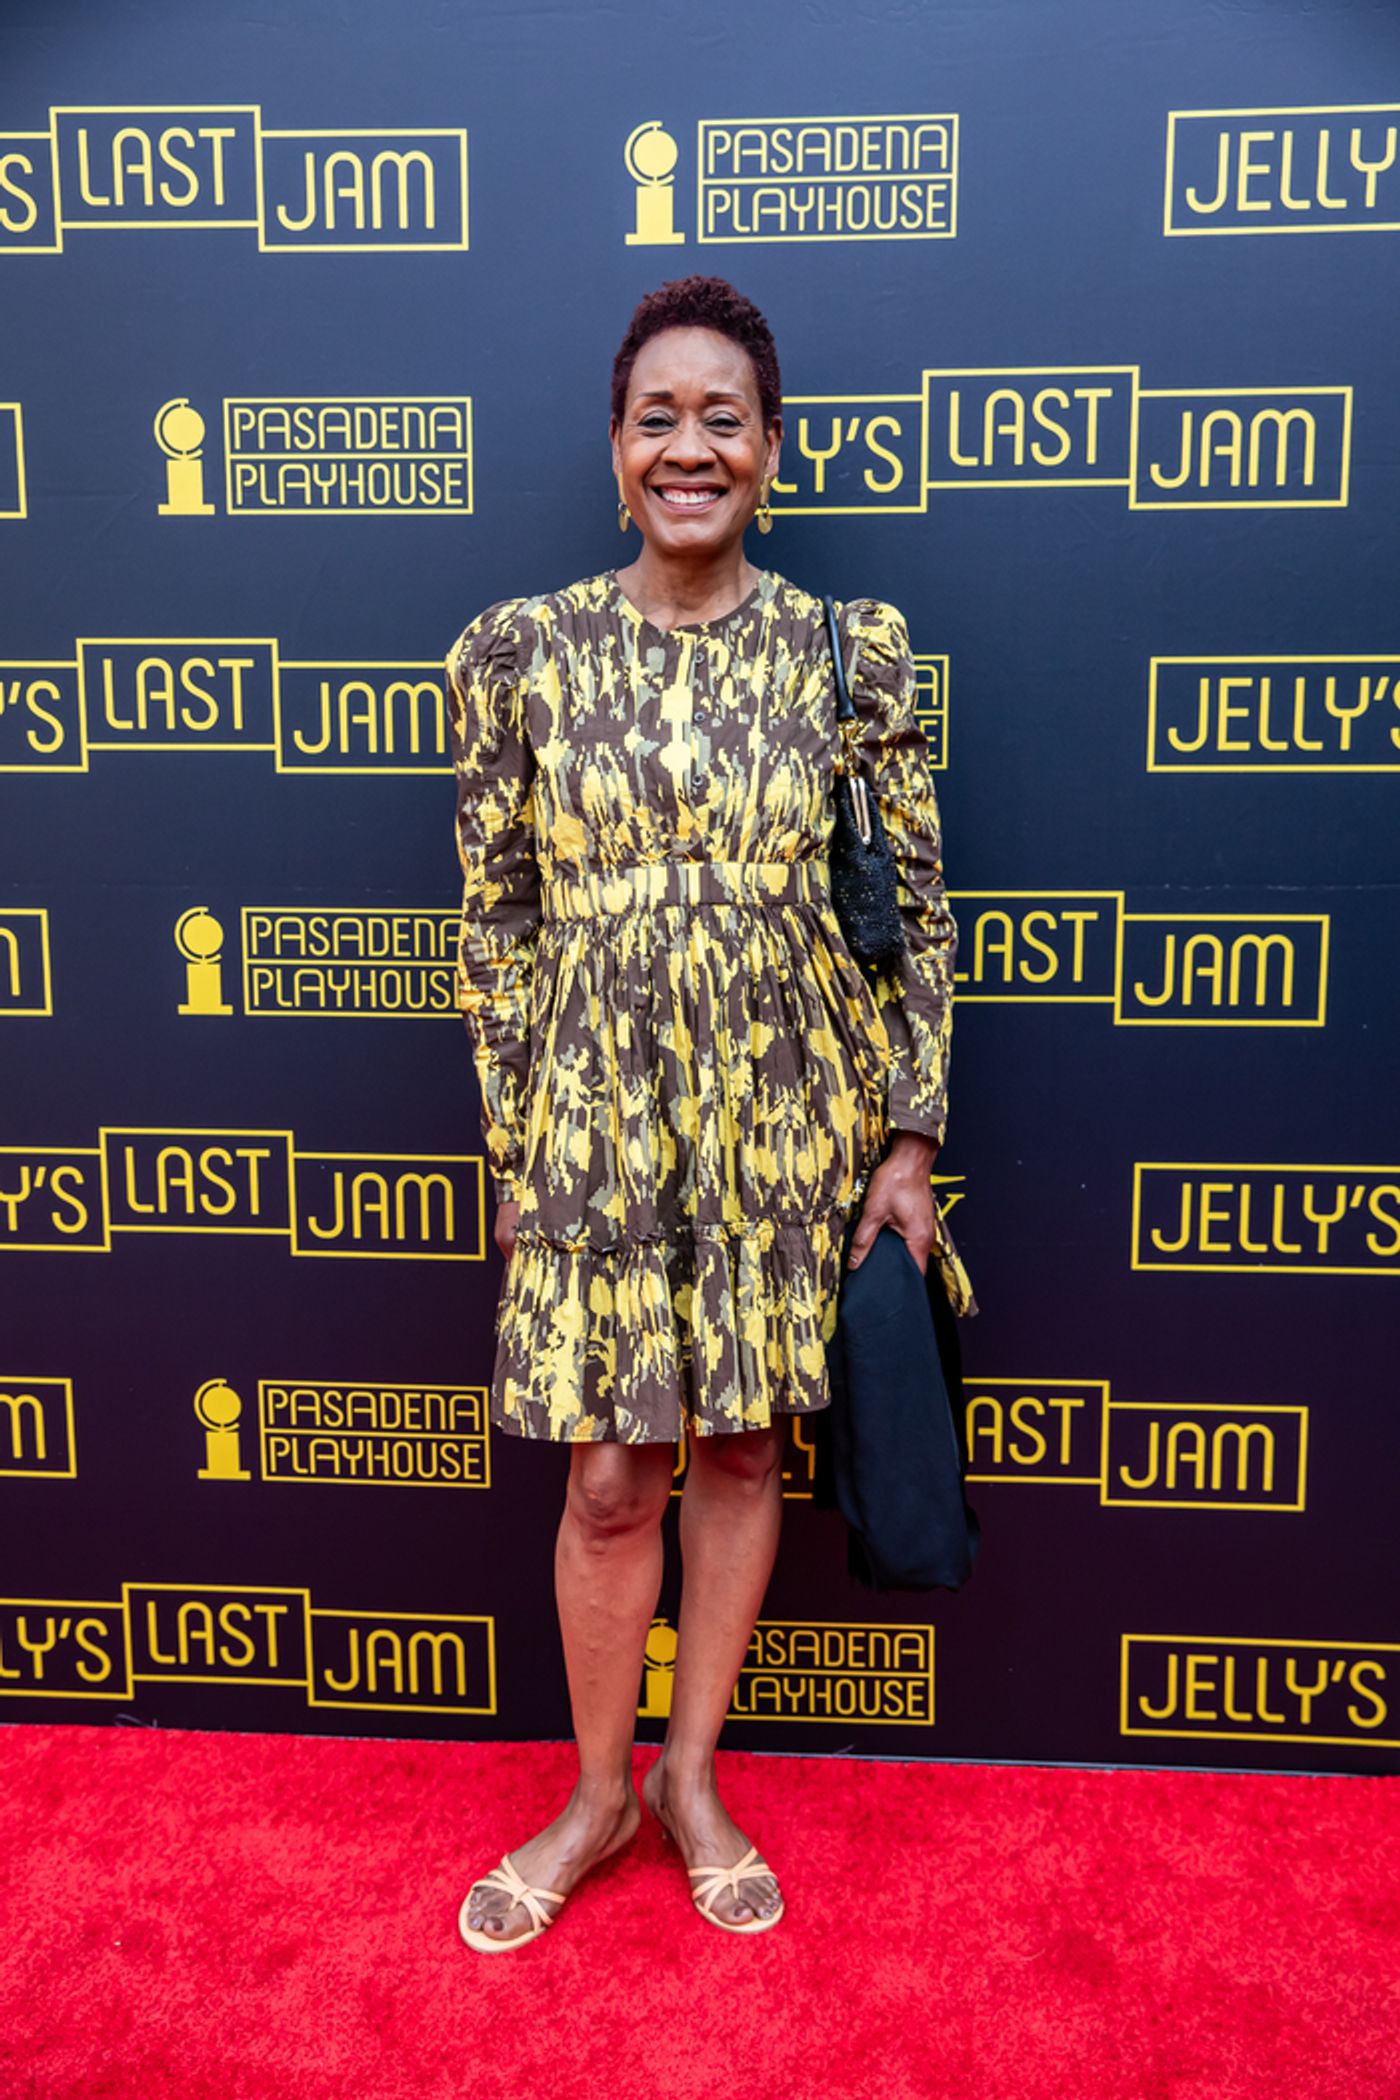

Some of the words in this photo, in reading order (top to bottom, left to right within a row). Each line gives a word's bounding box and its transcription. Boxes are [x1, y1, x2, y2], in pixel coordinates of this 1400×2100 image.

[78, 128, 235, 206] LAST
[277, 152, 434, 231] JAM
[708, 126, 947, 174] PASADENA
[707, 185, 946, 233] PLAYHOUSE
[233, 407, 462, 450] PASADENA
[950, 388, 1112, 467] LAST
[1150, 408, 1315, 489] JAM
[235, 463, 463, 506] PLAYHOUSE
[103, 657, 254, 731] LAST
[293, 681, 445, 755] JAM
[1167, 676, 1400, 753] JELLY'
[251, 916, 464, 957] PASADENA
[251, 967, 459, 1010] PLAYHOUS
[1134, 929, 1294, 1008] JAM
[125, 1145, 270, 1217] LAST
[308, 1172, 454, 1242] JAM
[1150, 1183, 1400, 1257] JELLY'S
[266, 1388, 479, 1432] PASADENA
[268, 1436, 482, 1480] PLAYHOUSE
[966, 1395, 1085, 1465] AST
[1120, 1421, 1275, 1492] JAM
[147, 1600, 288, 1668] LAST
[324, 1628, 466, 1697] JAM
[749, 1628, 925, 1670] ASADENA
[733, 1676, 926, 1718] LAYHOUSE
[1139, 1653, 1387, 1730] JELLY'S
